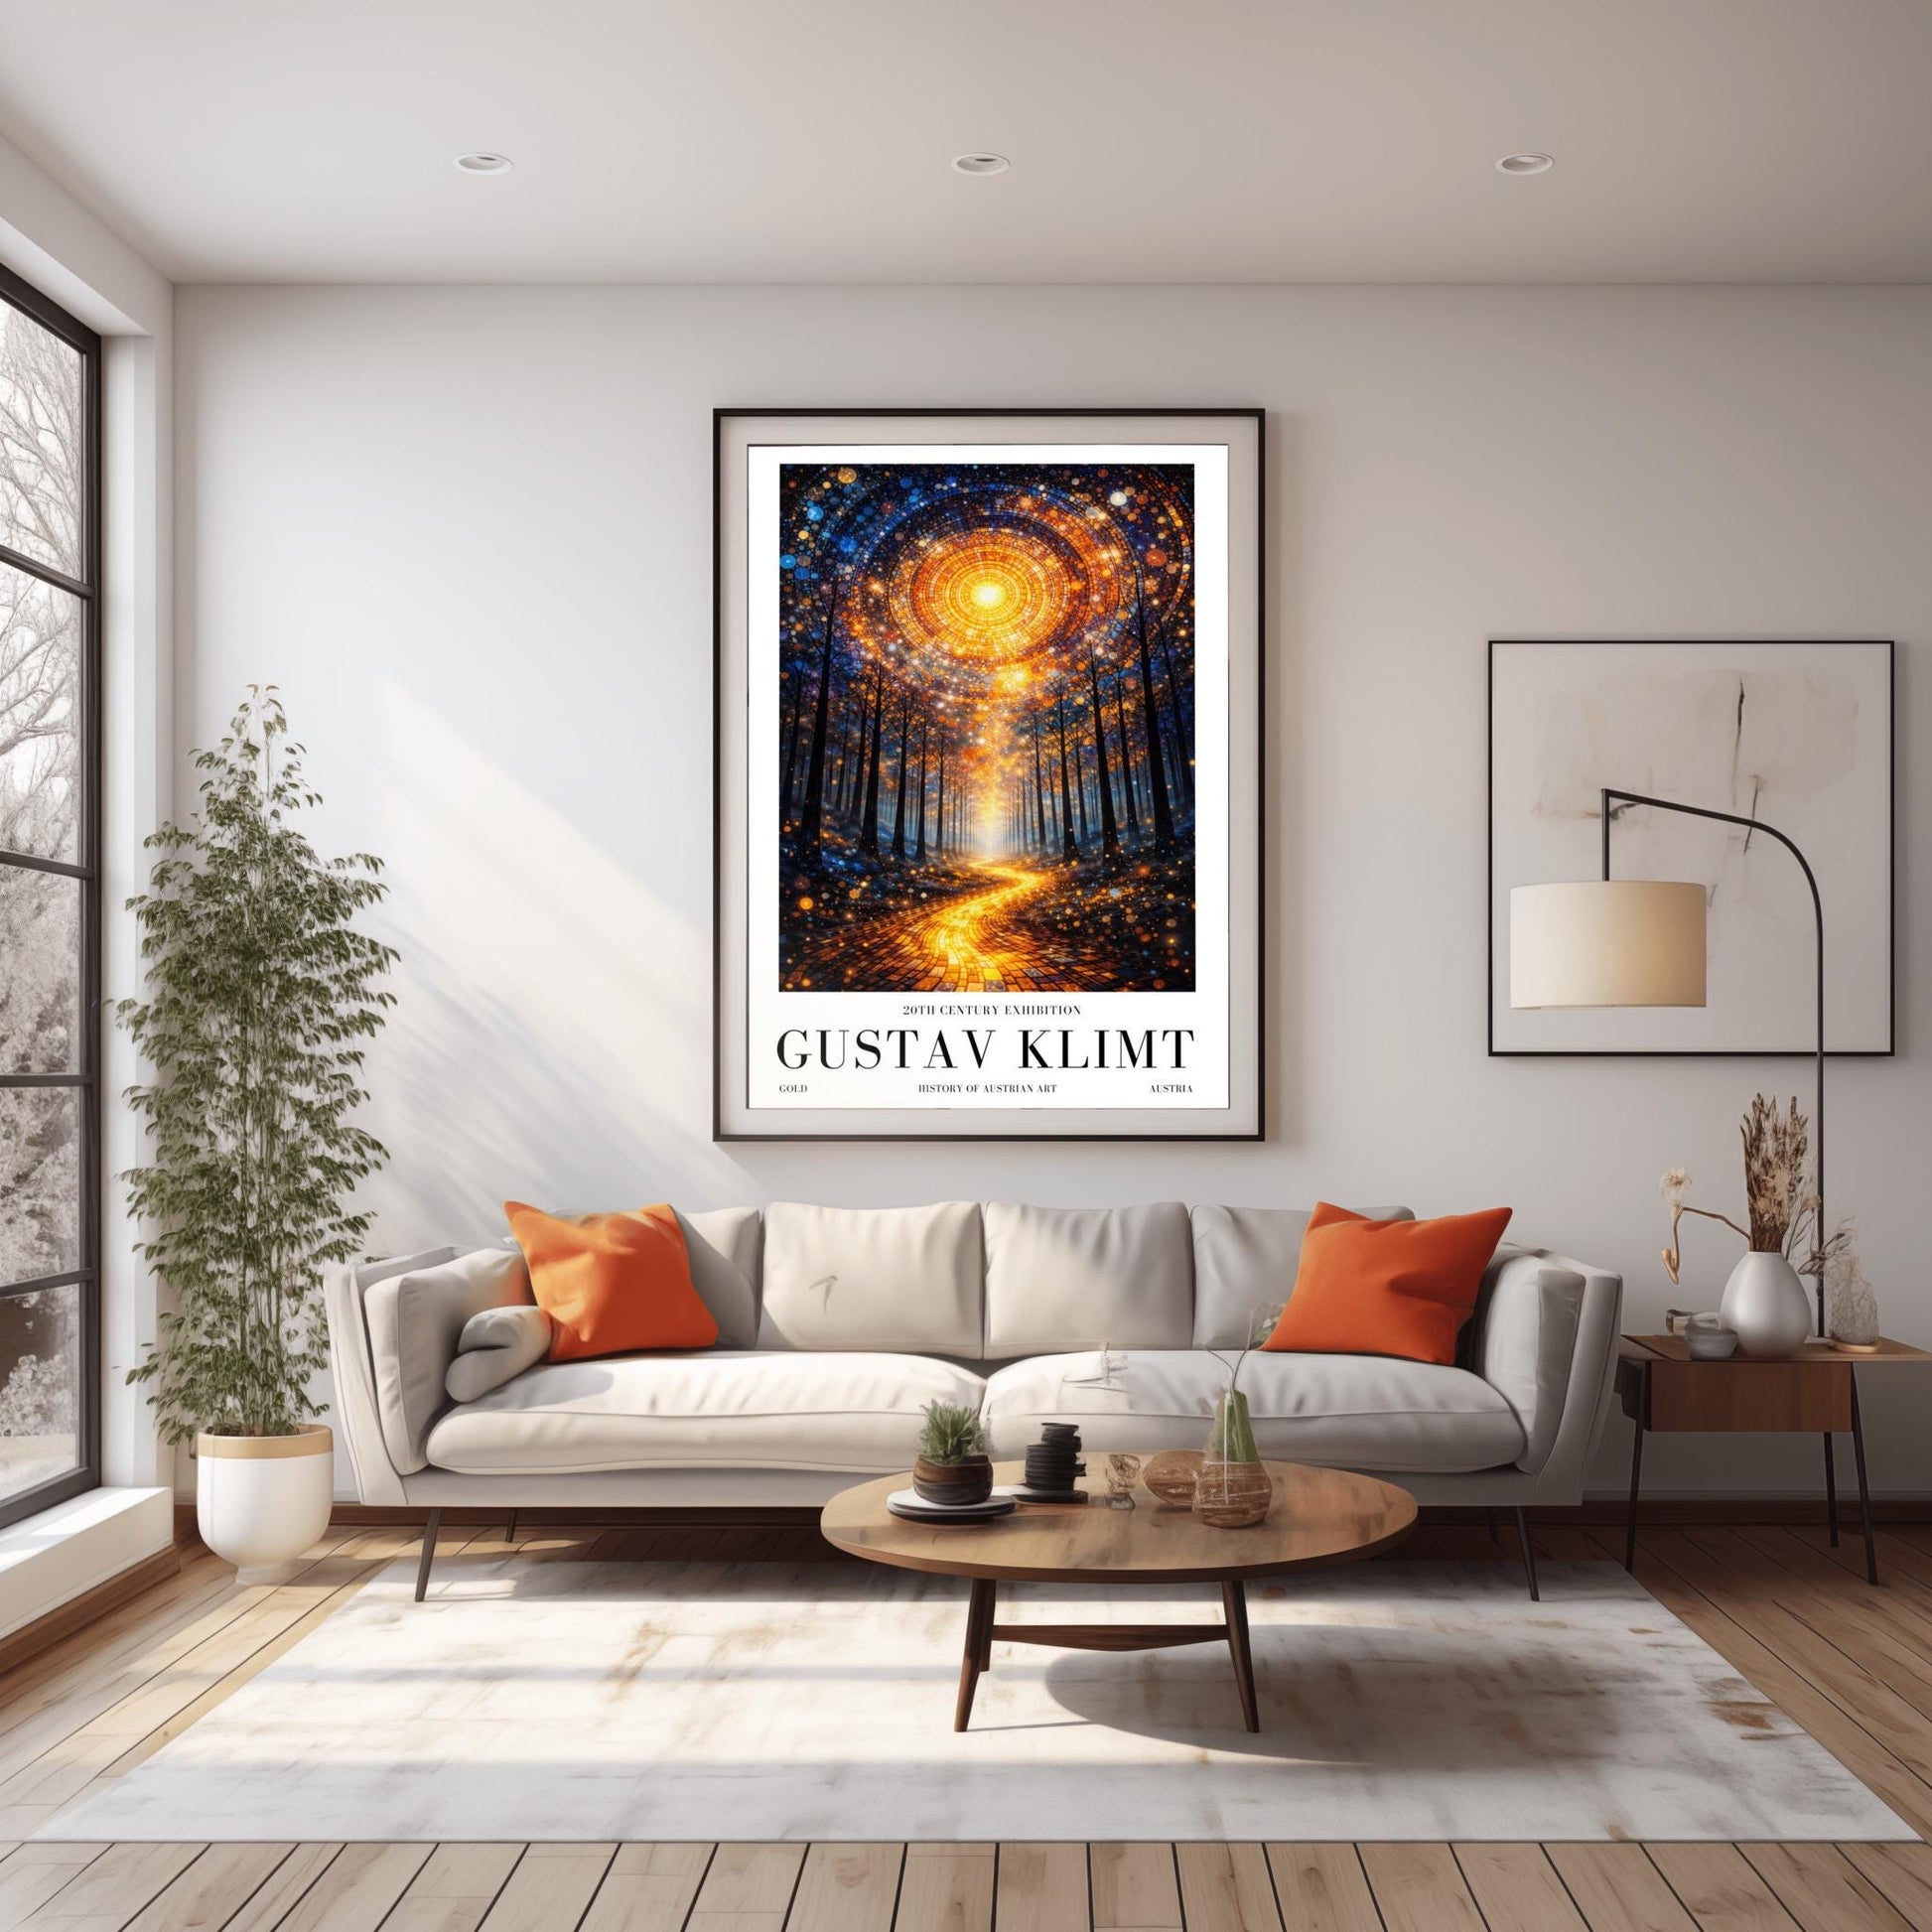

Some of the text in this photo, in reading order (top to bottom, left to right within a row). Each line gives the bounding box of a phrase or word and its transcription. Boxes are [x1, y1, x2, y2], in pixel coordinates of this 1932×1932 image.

[902, 1005, 1081, 1016] 20TH CENTURY EXHIBITION
[776, 1030, 1194, 1069] GUSTAV KLIMT
[778, 1083, 808, 1093] GOLD
[918, 1083, 1057, 1094] HISTORY OF AUSTRIAN ART
[1150, 1083, 1193, 1094] AUSTRIA
